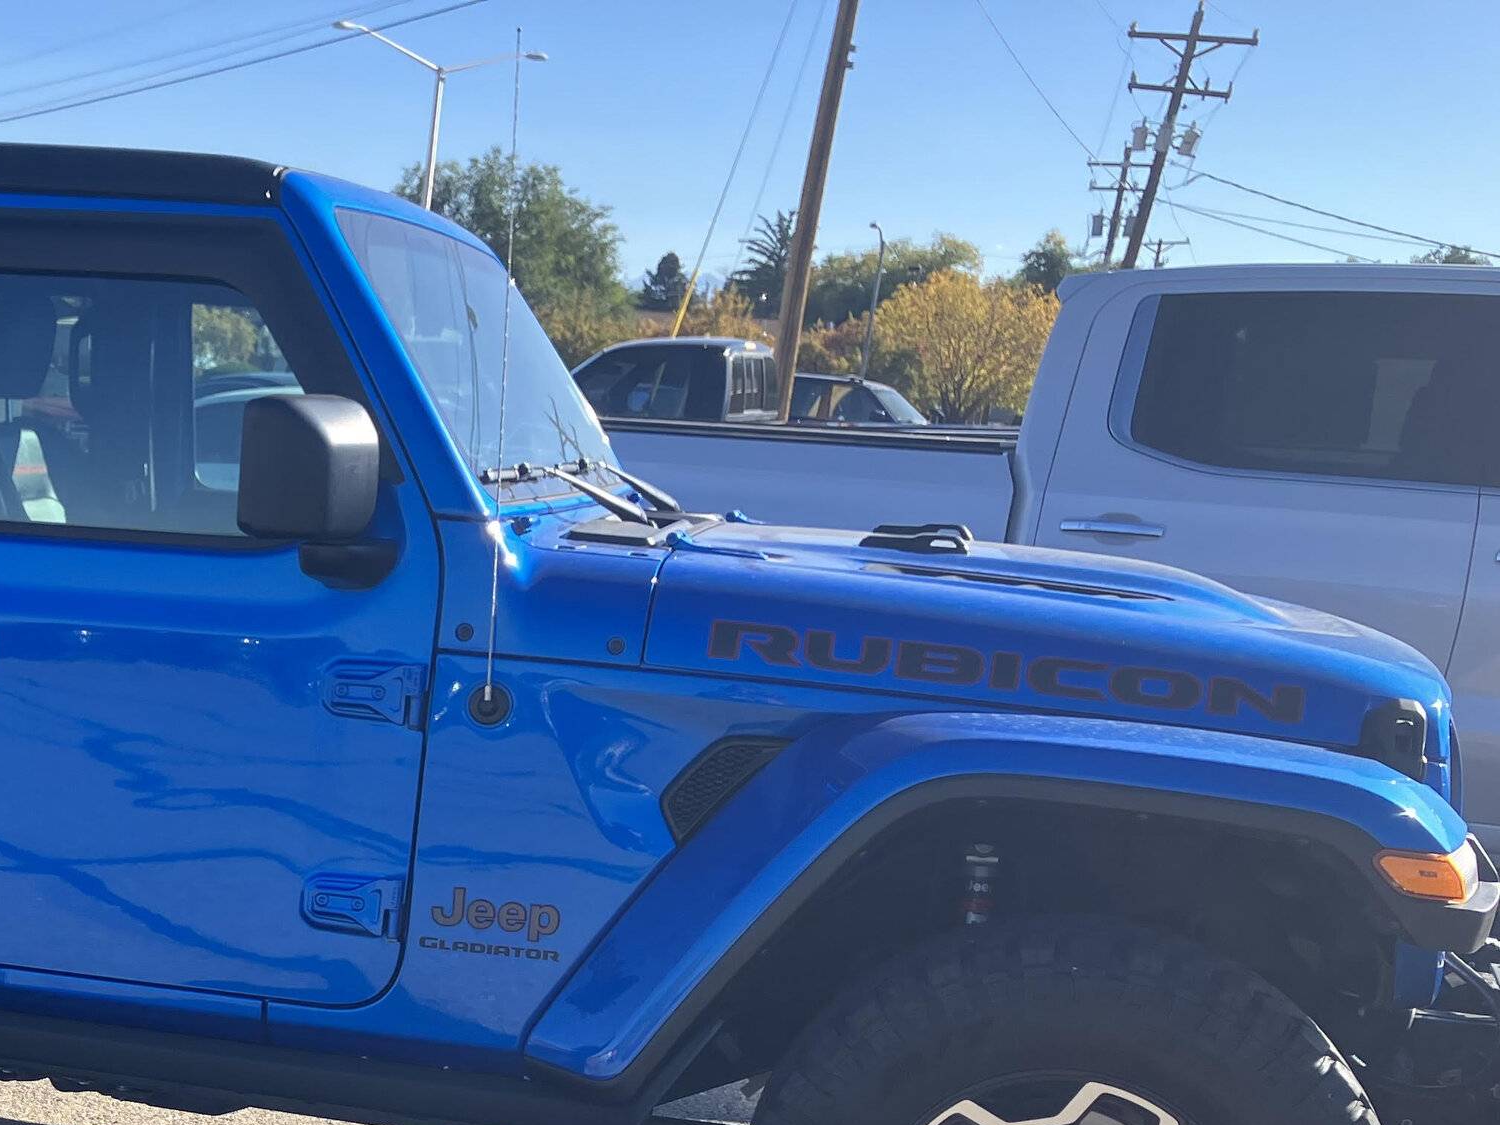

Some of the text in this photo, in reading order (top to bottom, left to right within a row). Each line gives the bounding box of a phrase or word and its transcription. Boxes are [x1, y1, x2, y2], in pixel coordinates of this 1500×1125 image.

[707, 619, 1304, 724] RUBICON
[431, 886, 561, 942] Jeep
[419, 936, 560, 962] GLADIATOR
